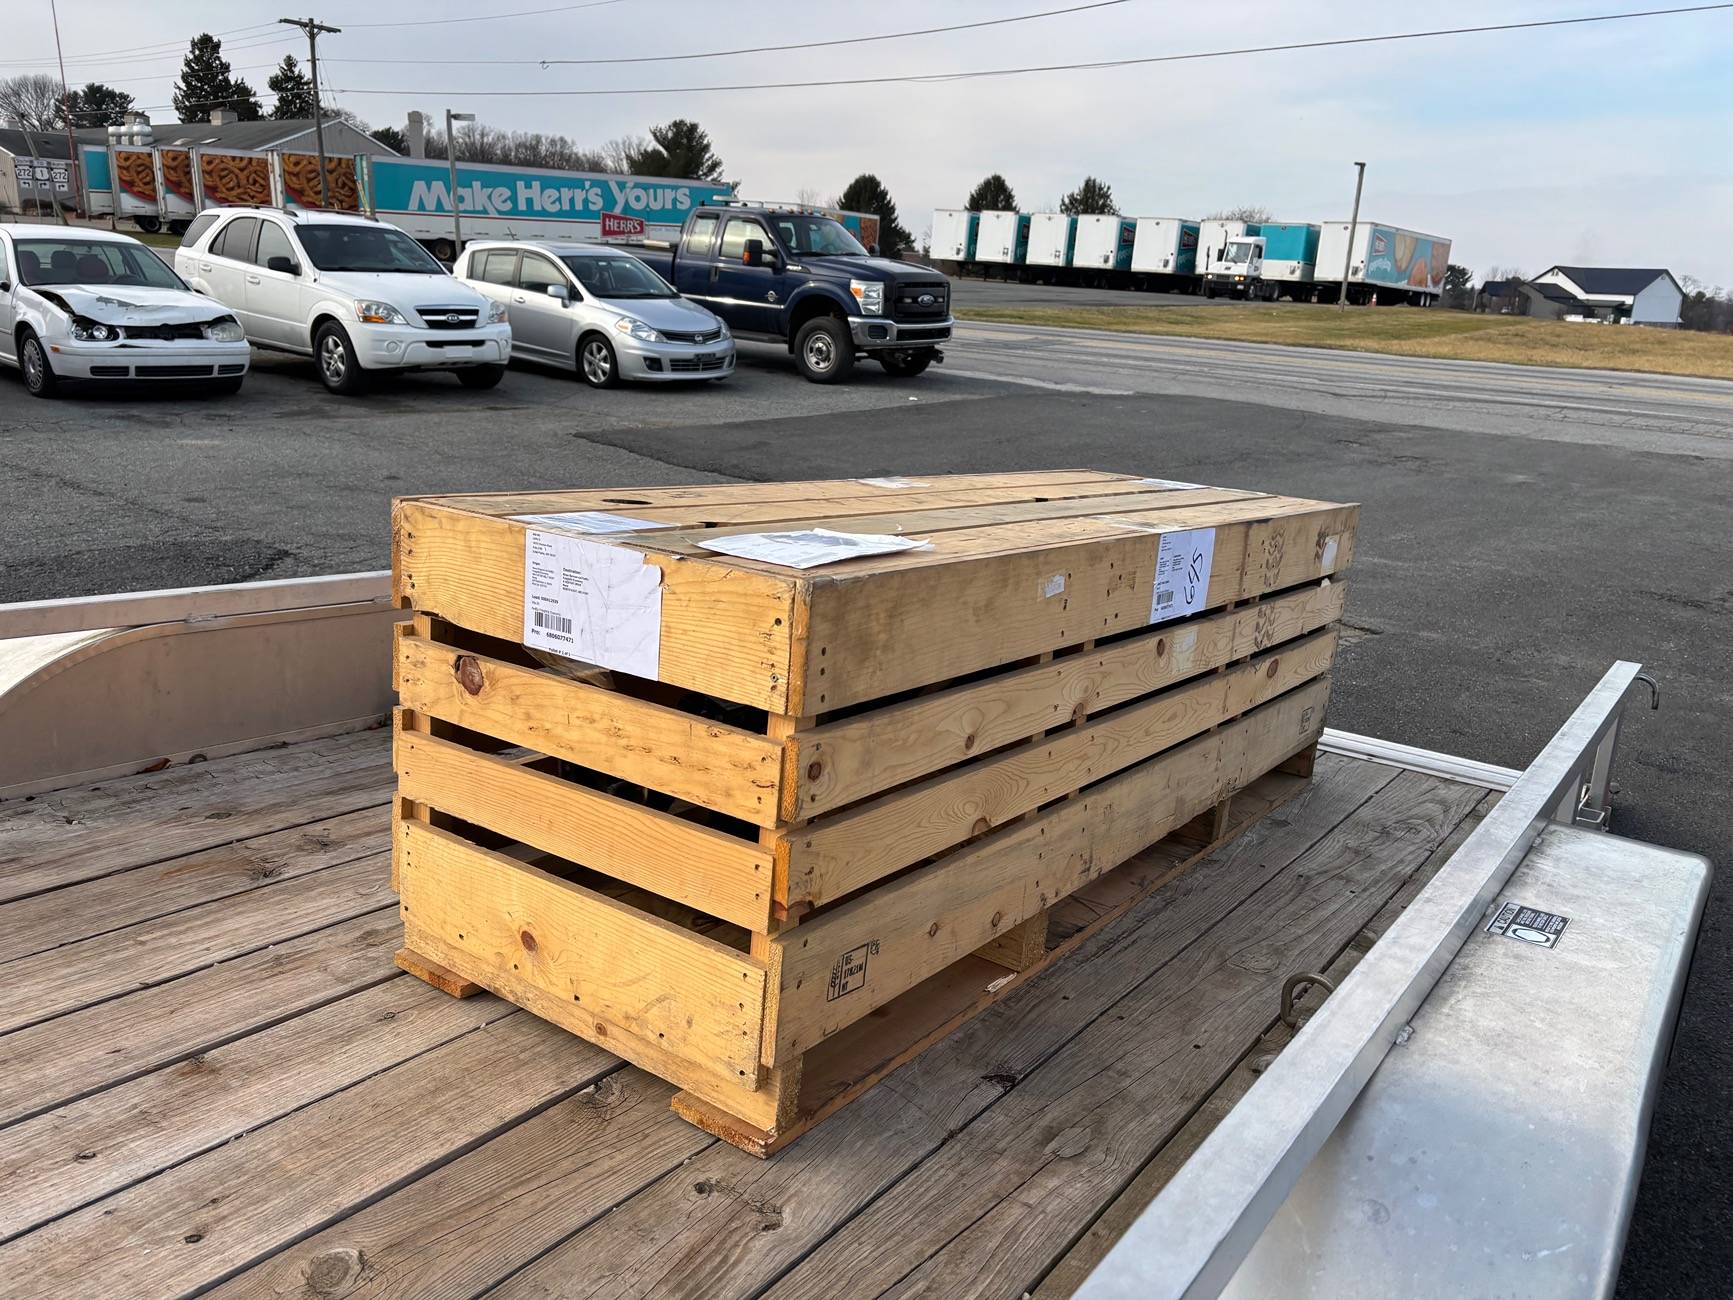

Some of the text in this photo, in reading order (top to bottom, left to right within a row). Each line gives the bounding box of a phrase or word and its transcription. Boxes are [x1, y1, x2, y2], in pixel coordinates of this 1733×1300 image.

[17, 168, 32, 177] 272
[53, 171, 67, 180] 272
[408, 180, 690, 215] Make Herr's Yours
[605, 217, 641, 233] HERR'S
